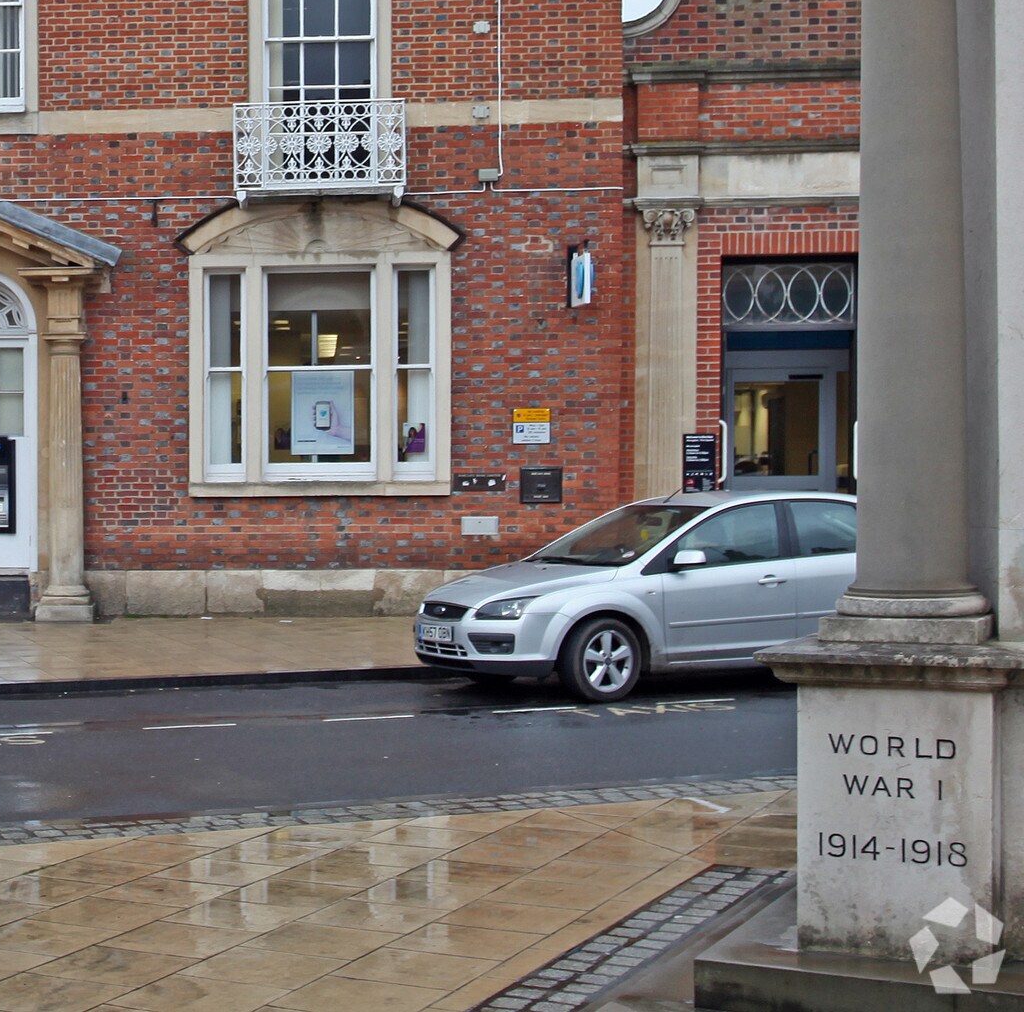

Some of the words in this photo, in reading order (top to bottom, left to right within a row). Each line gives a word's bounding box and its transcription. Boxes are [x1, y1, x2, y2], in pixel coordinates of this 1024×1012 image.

[828, 733, 957, 760] WORLD
[842, 774, 916, 799] WAR
[937, 779, 943, 801] I
[818, 832, 969, 868] 1914-1918
